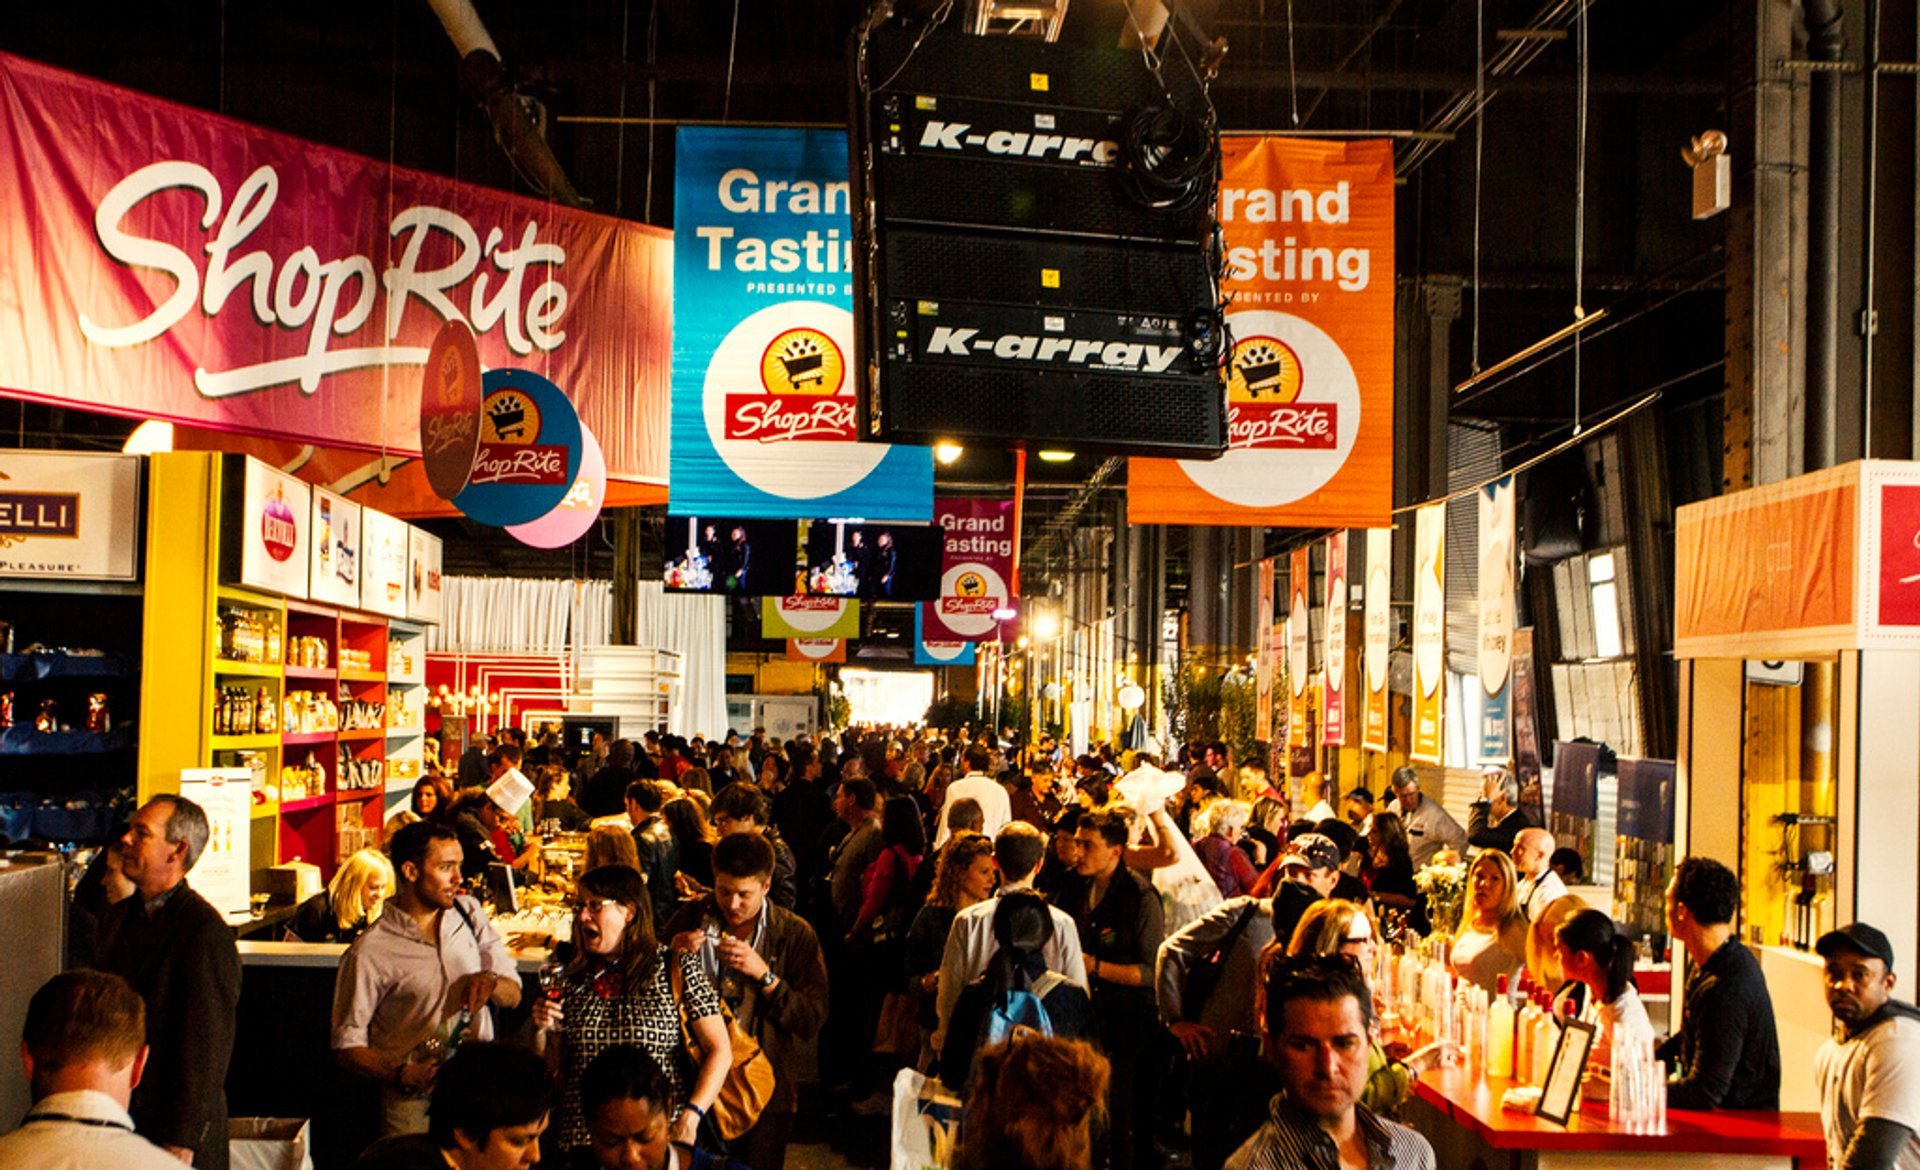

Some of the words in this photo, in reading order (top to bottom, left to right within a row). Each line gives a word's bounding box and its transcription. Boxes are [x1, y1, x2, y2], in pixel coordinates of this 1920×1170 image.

[919, 121, 1119, 163] K-arra
[718, 168, 851, 214] Gran
[1222, 181, 1349, 223] rand
[696, 226, 852, 273] Tasti
[1228, 237, 1370, 291] sting
[79, 160, 568, 397] ShopRite
[747, 282, 836, 295] PRESENTED
[844, 284, 852, 295] B
[926, 326, 1184, 373] K-array
[732, 399, 856, 443] ShopRit
[1228, 407, 1330, 448] hopRite
[472, 448, 561, 484] hopRite
[940, 514, 1005, 532] Grand
[943, 536, 1012, 556] asting
